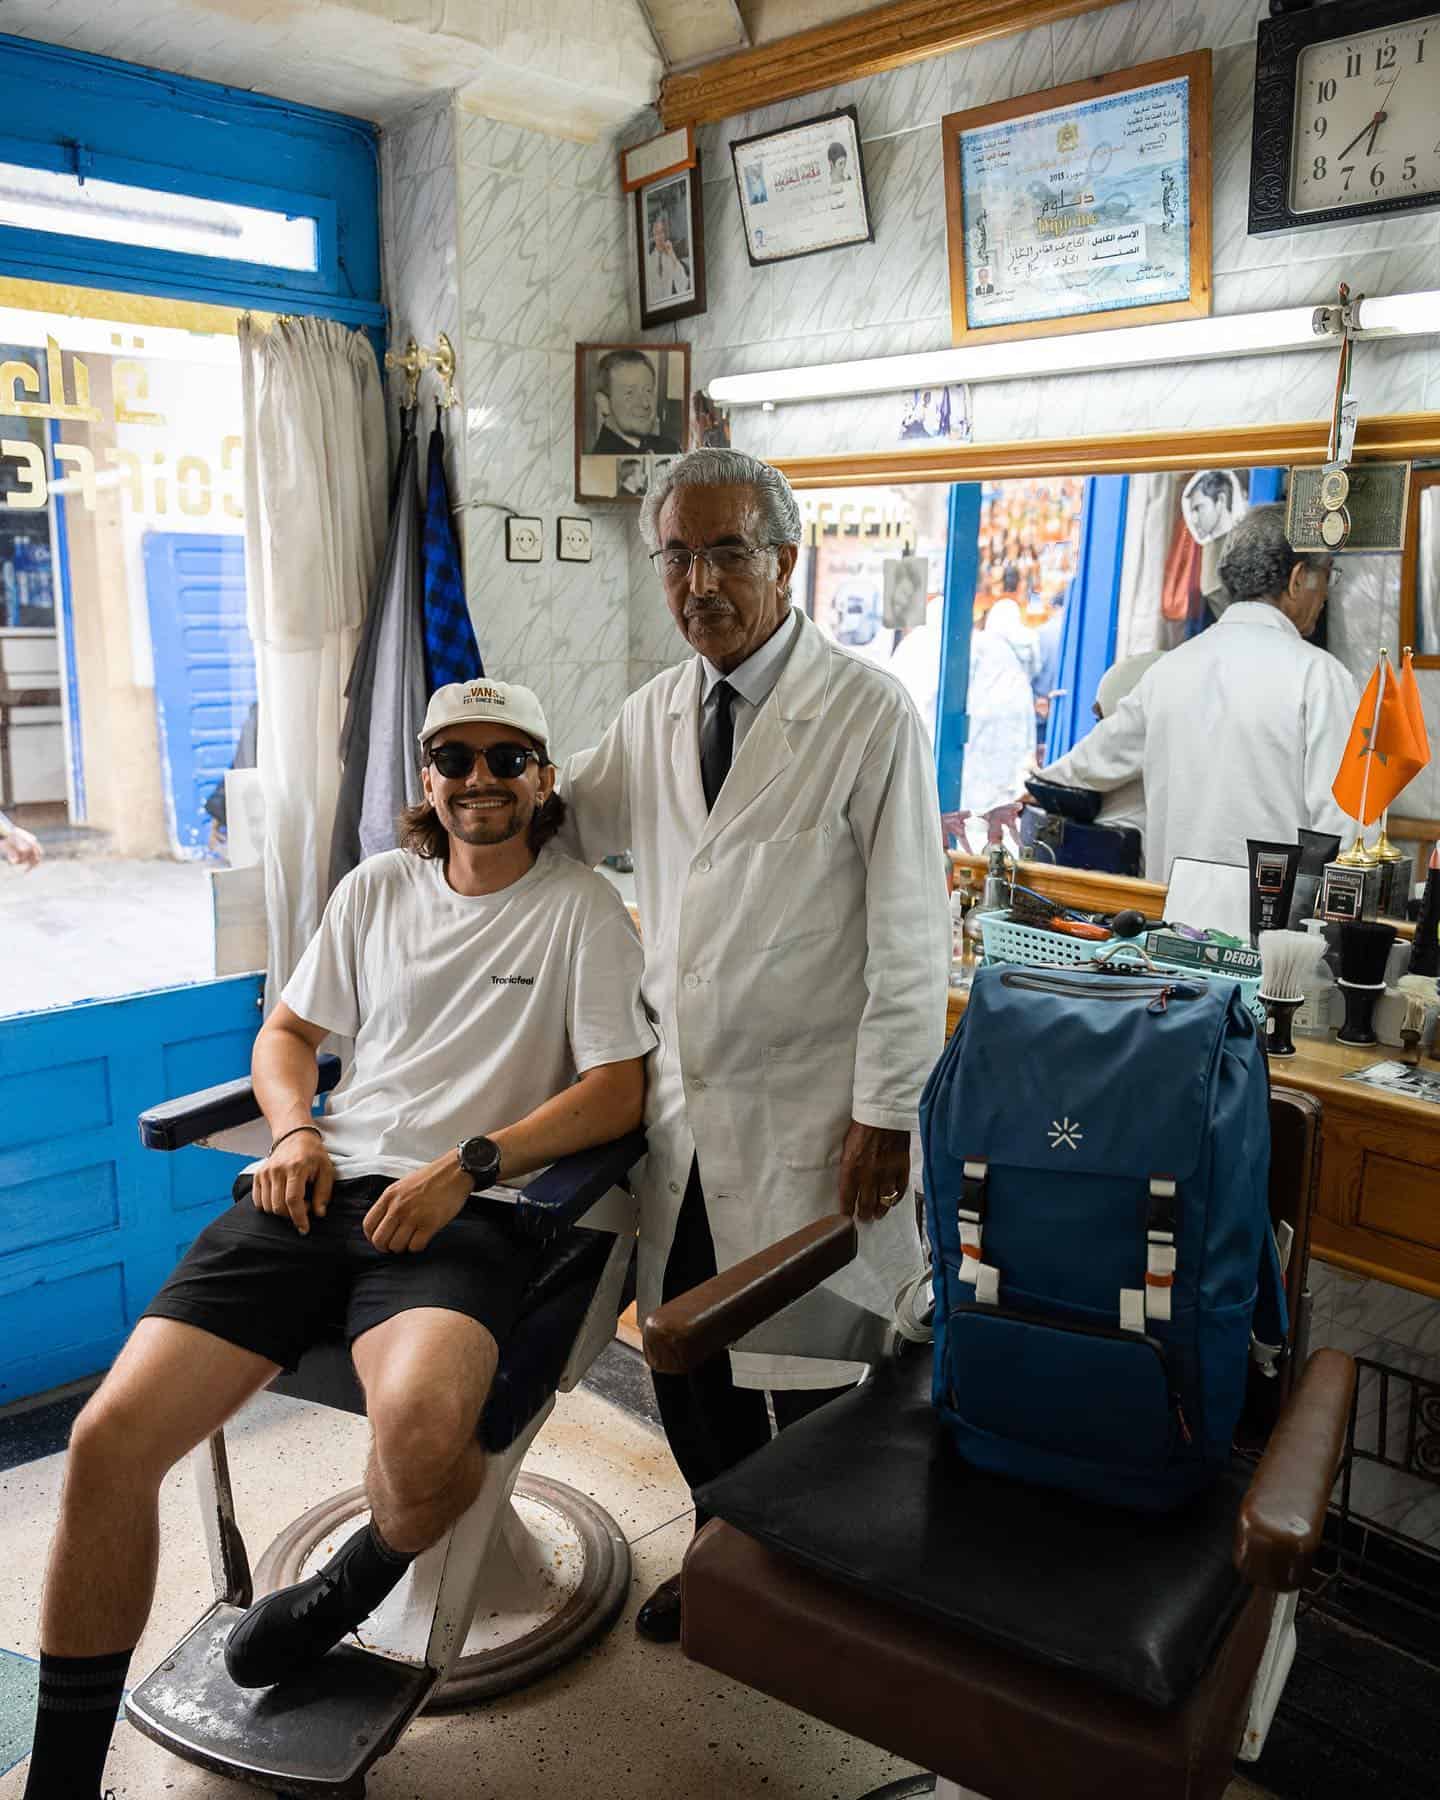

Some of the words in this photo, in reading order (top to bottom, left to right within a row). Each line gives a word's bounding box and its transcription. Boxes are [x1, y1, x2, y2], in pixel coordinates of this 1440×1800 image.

[1375, 45, 1397, 71] 12
[1415, 38, 1425, 64] 1
[1344, 53, 1361, 78] 11
[1316, 78, 1337, 104] 10
[1314, 117, 1328, 140] 9
[1313, 155, 1327, 181] 8
[1340, 165, 1355, 190] 7
[1370, 162, 1385, 188] 6
[1402, 155, 1416, 181] 5
[470, 687, 498, 697] VANS
[1222, 949, 1262, 968] DERBY
